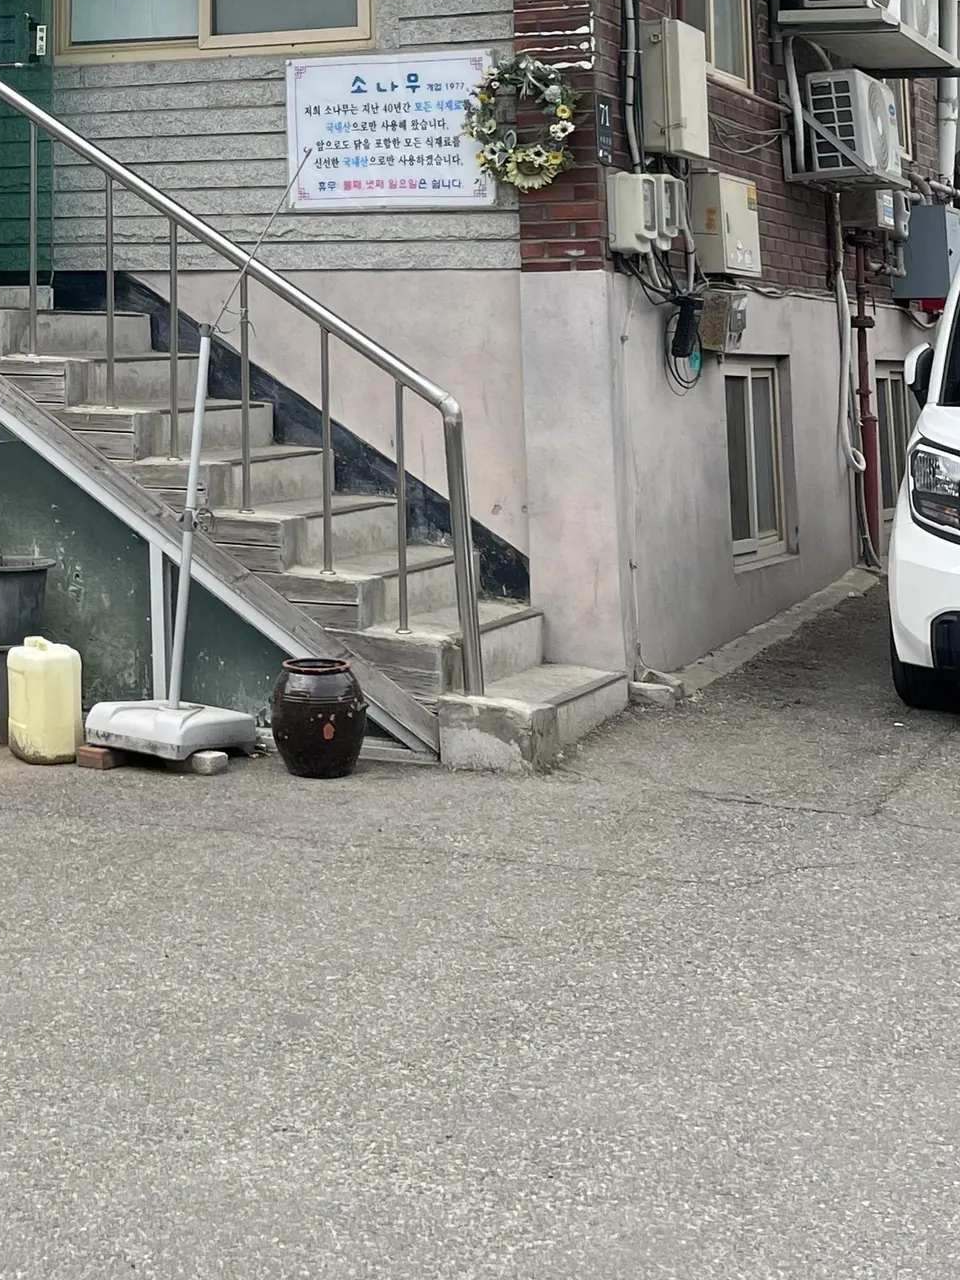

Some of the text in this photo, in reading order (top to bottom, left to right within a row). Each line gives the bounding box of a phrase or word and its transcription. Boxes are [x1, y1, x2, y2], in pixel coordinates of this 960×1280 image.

[426, 83, 442, 92] 개업
[445, 82, 465, 91] 1977
[304, 104, 321, 117] 저희
[324, 103, 359, 116] 소나무는
[362, 102, 380, 115] 지난
[382, 101, 411, 114] 40년간
[414, 100, 433, 112] 모든
[599, 103, 610, 127] 71
[326, 117, 449, 133] 국내산으로만 사용해 왔습니다.
[316, 135, 461, 152] 앞으로도 닭을 포함한 모든 식재료를
[314, 153, 464, 169] 신선한 국내산으로만 사용하겠습니다.
[388, 178, 428, 189] 일요일은
